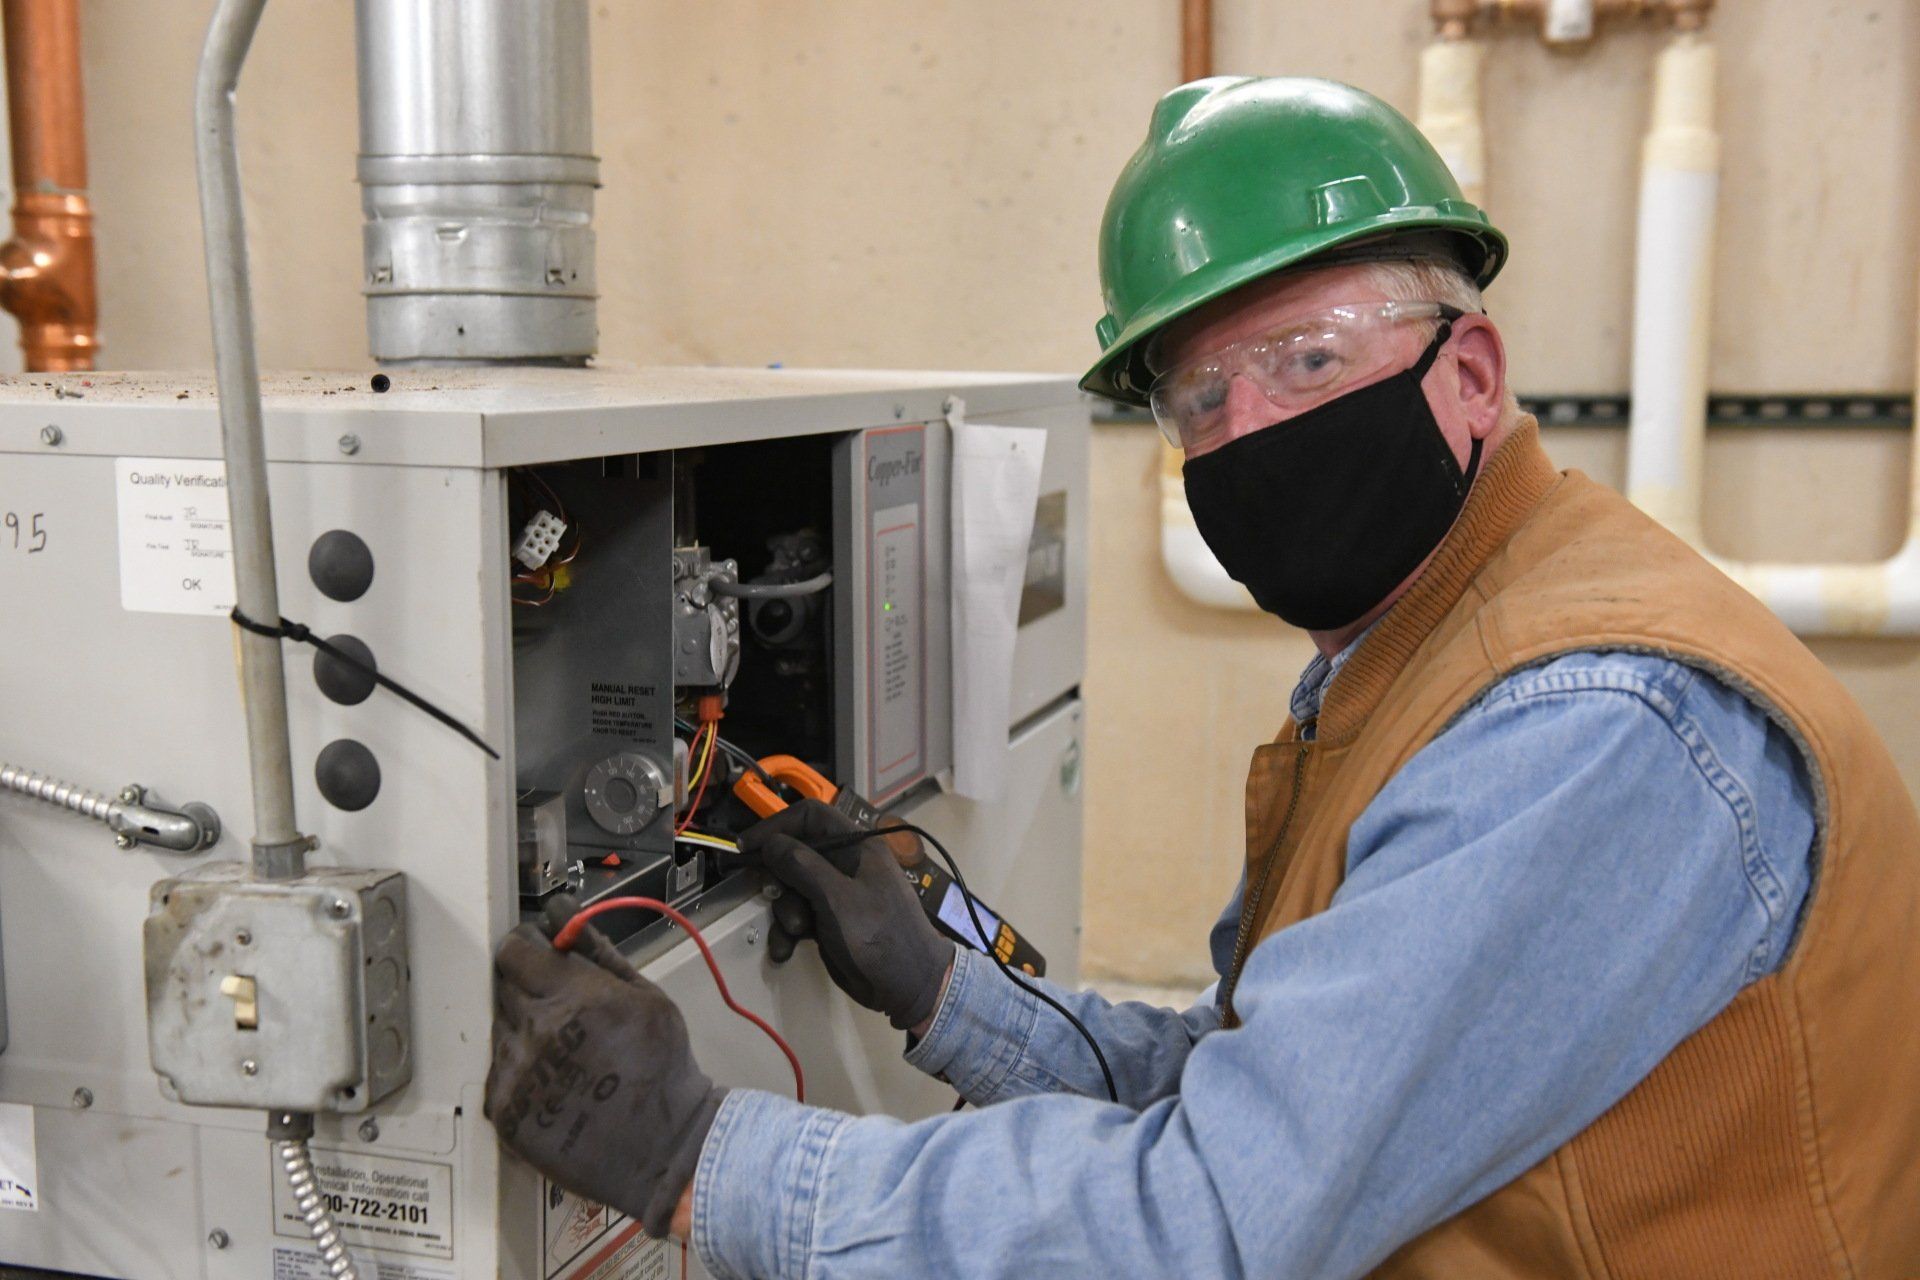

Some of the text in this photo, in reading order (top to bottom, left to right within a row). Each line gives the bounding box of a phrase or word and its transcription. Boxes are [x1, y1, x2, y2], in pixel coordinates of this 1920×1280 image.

[130, 472, 170, 488] Quality
[0, 511, 47, 553] 95
[182, 578, 202, 591] OK
[591, 682, 656, 696] MANUAL RESET
[591, 695, 635, 706] HIGH LIMIT
[316, 1166, 428, 1189] nstallation, Operational
[320, 1179, 429, 1202] hnical Information call
[322, 1193, 427, 1224] 00-722-2101
